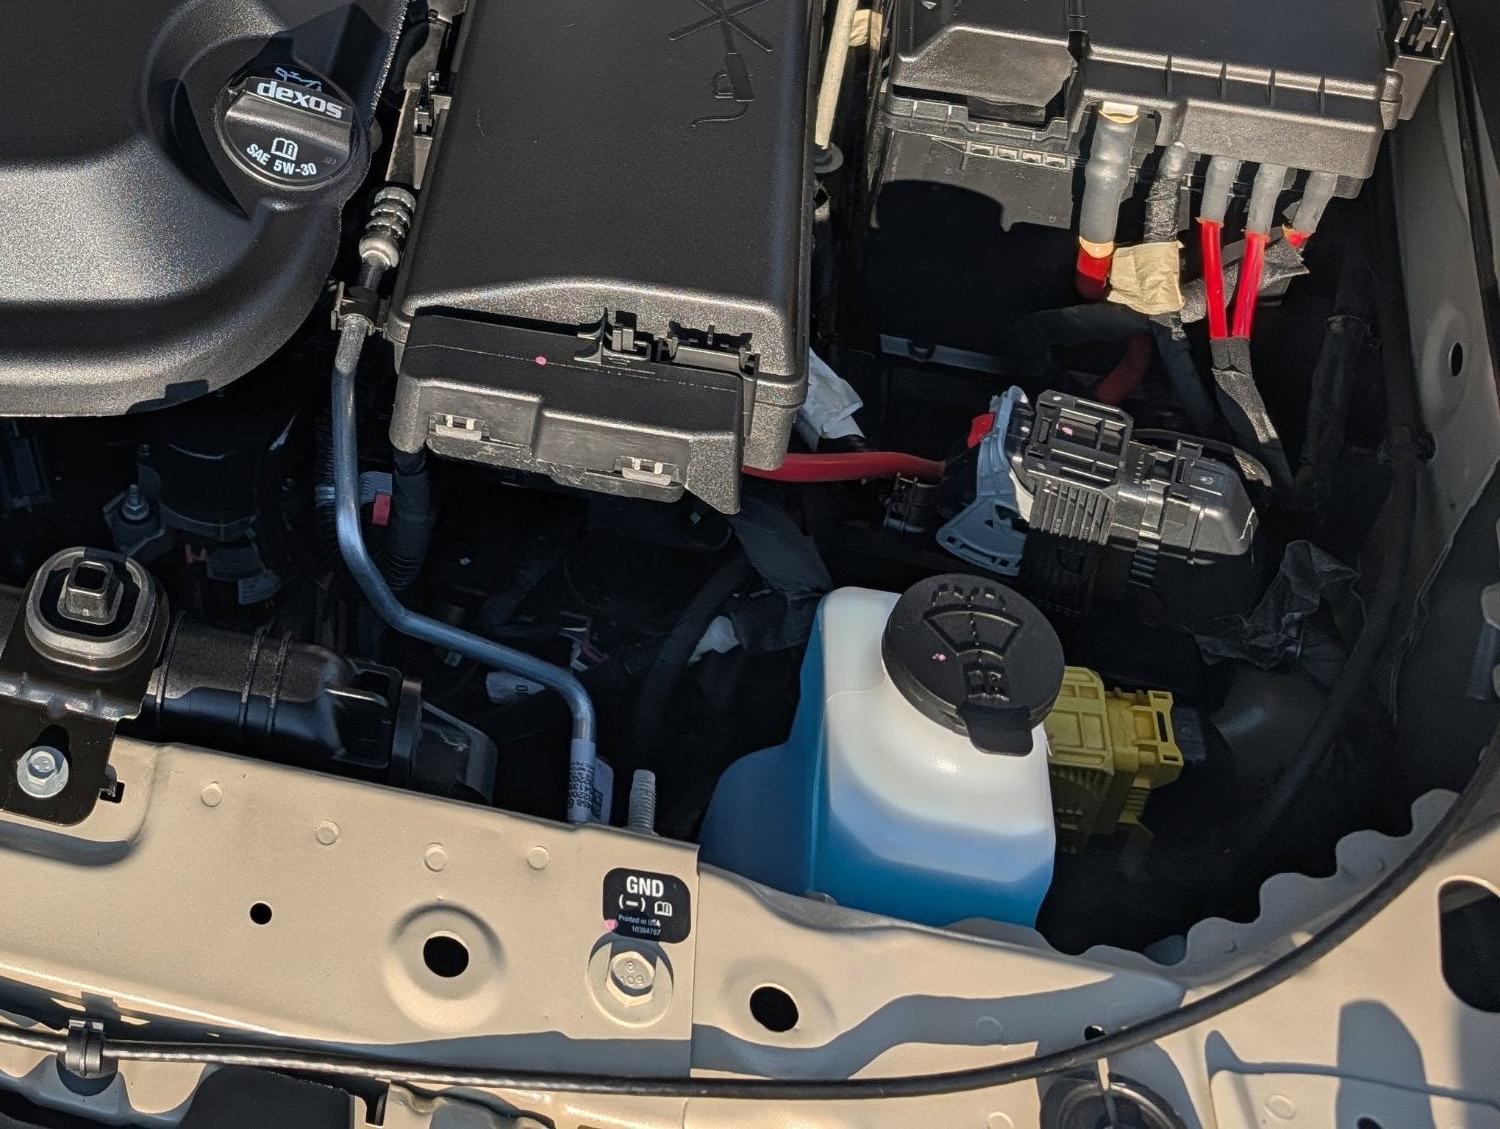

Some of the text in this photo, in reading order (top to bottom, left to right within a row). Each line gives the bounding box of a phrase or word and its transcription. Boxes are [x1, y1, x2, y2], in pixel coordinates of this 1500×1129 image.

[256, 80, 343, 119] dexos
[246, 143, 271, 166] SAE
[273, 159, 317, 176] 5W-30
[626, 875, 664, 898] GND
[618, 914, 640, 923] Printed
